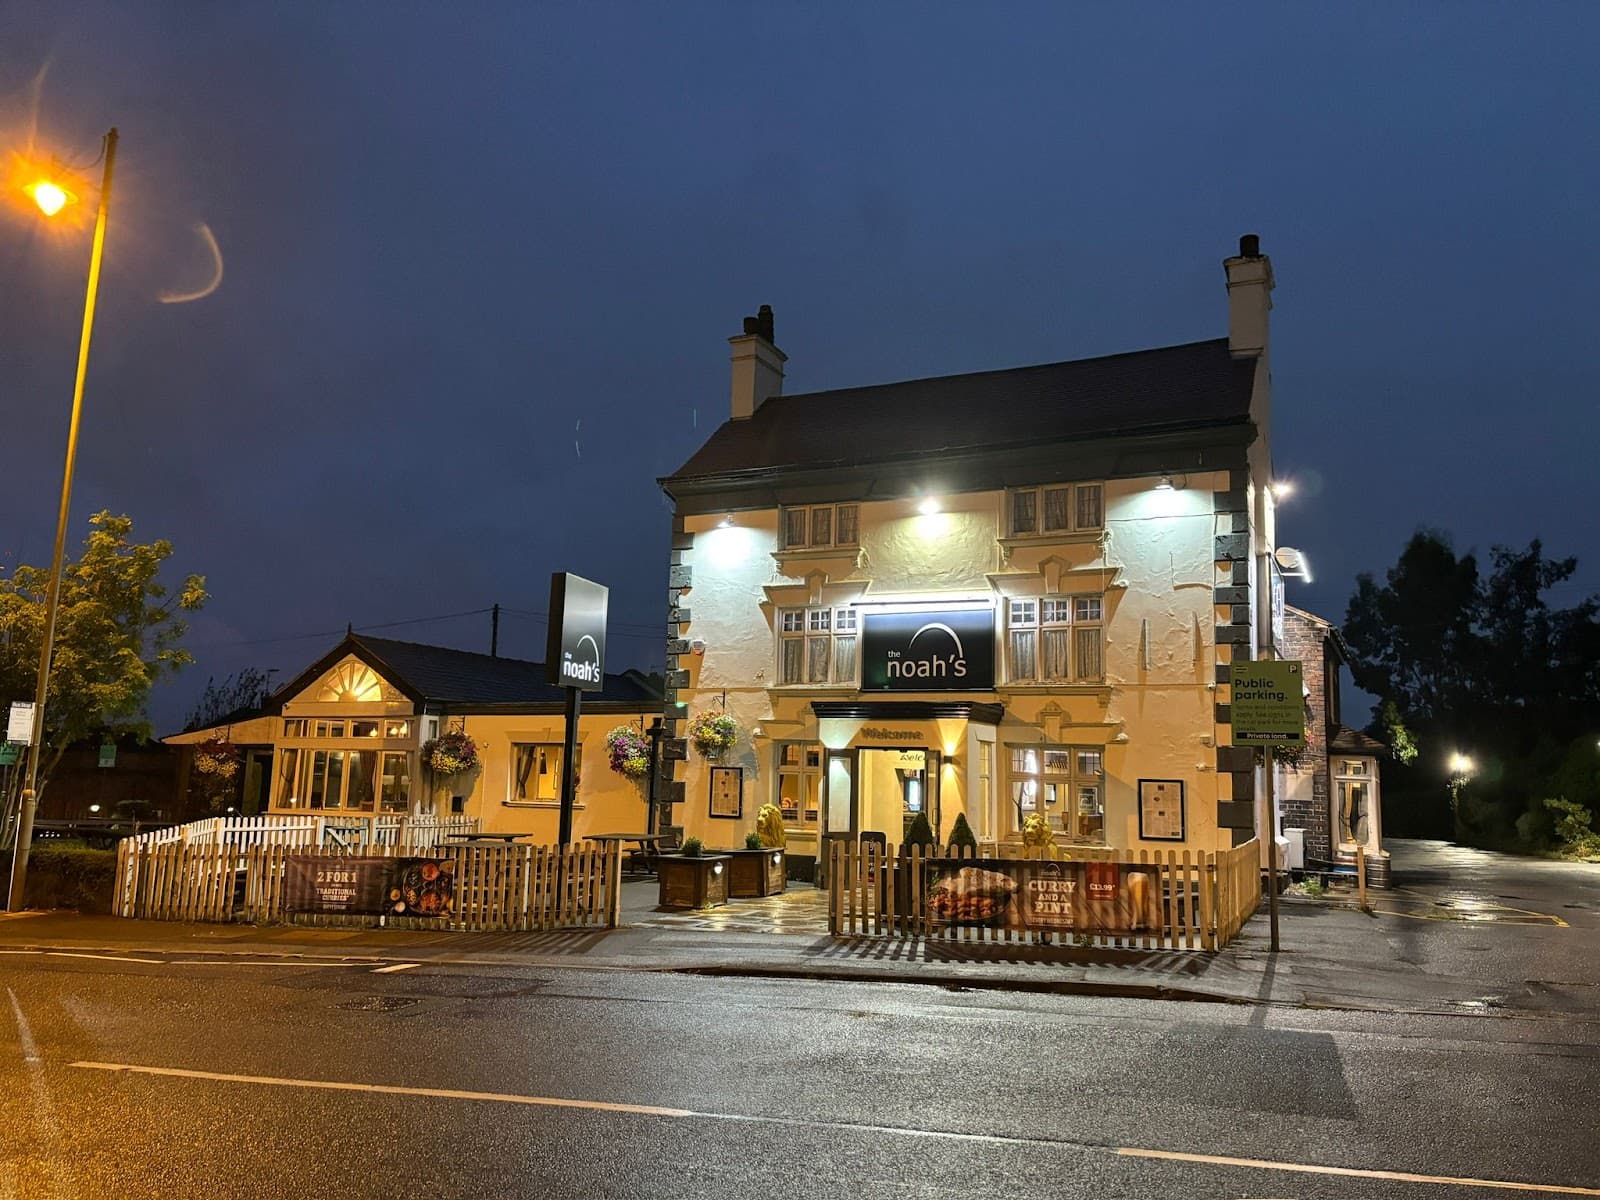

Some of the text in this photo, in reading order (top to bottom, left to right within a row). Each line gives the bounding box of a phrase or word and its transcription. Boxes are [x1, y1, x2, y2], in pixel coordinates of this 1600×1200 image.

[887, 650, 901, 658] the
[563, 660, 600, 683] noah's
[887, 654, 967, 678] noah's
[1235, 678, 1274, 688] Public
[1235, 690, 1288, 702] parking.
[860, 727, 925, 740] Welcome
[317, 871, 357, 883] 2 FOR 1
[316, 888, 356, 896] TRADITIONAL
[1028, 880, 1077, 893] CURRY
[1038, 893, 1059, 901] AND
[1034, 901, 1072, 914] PINT
